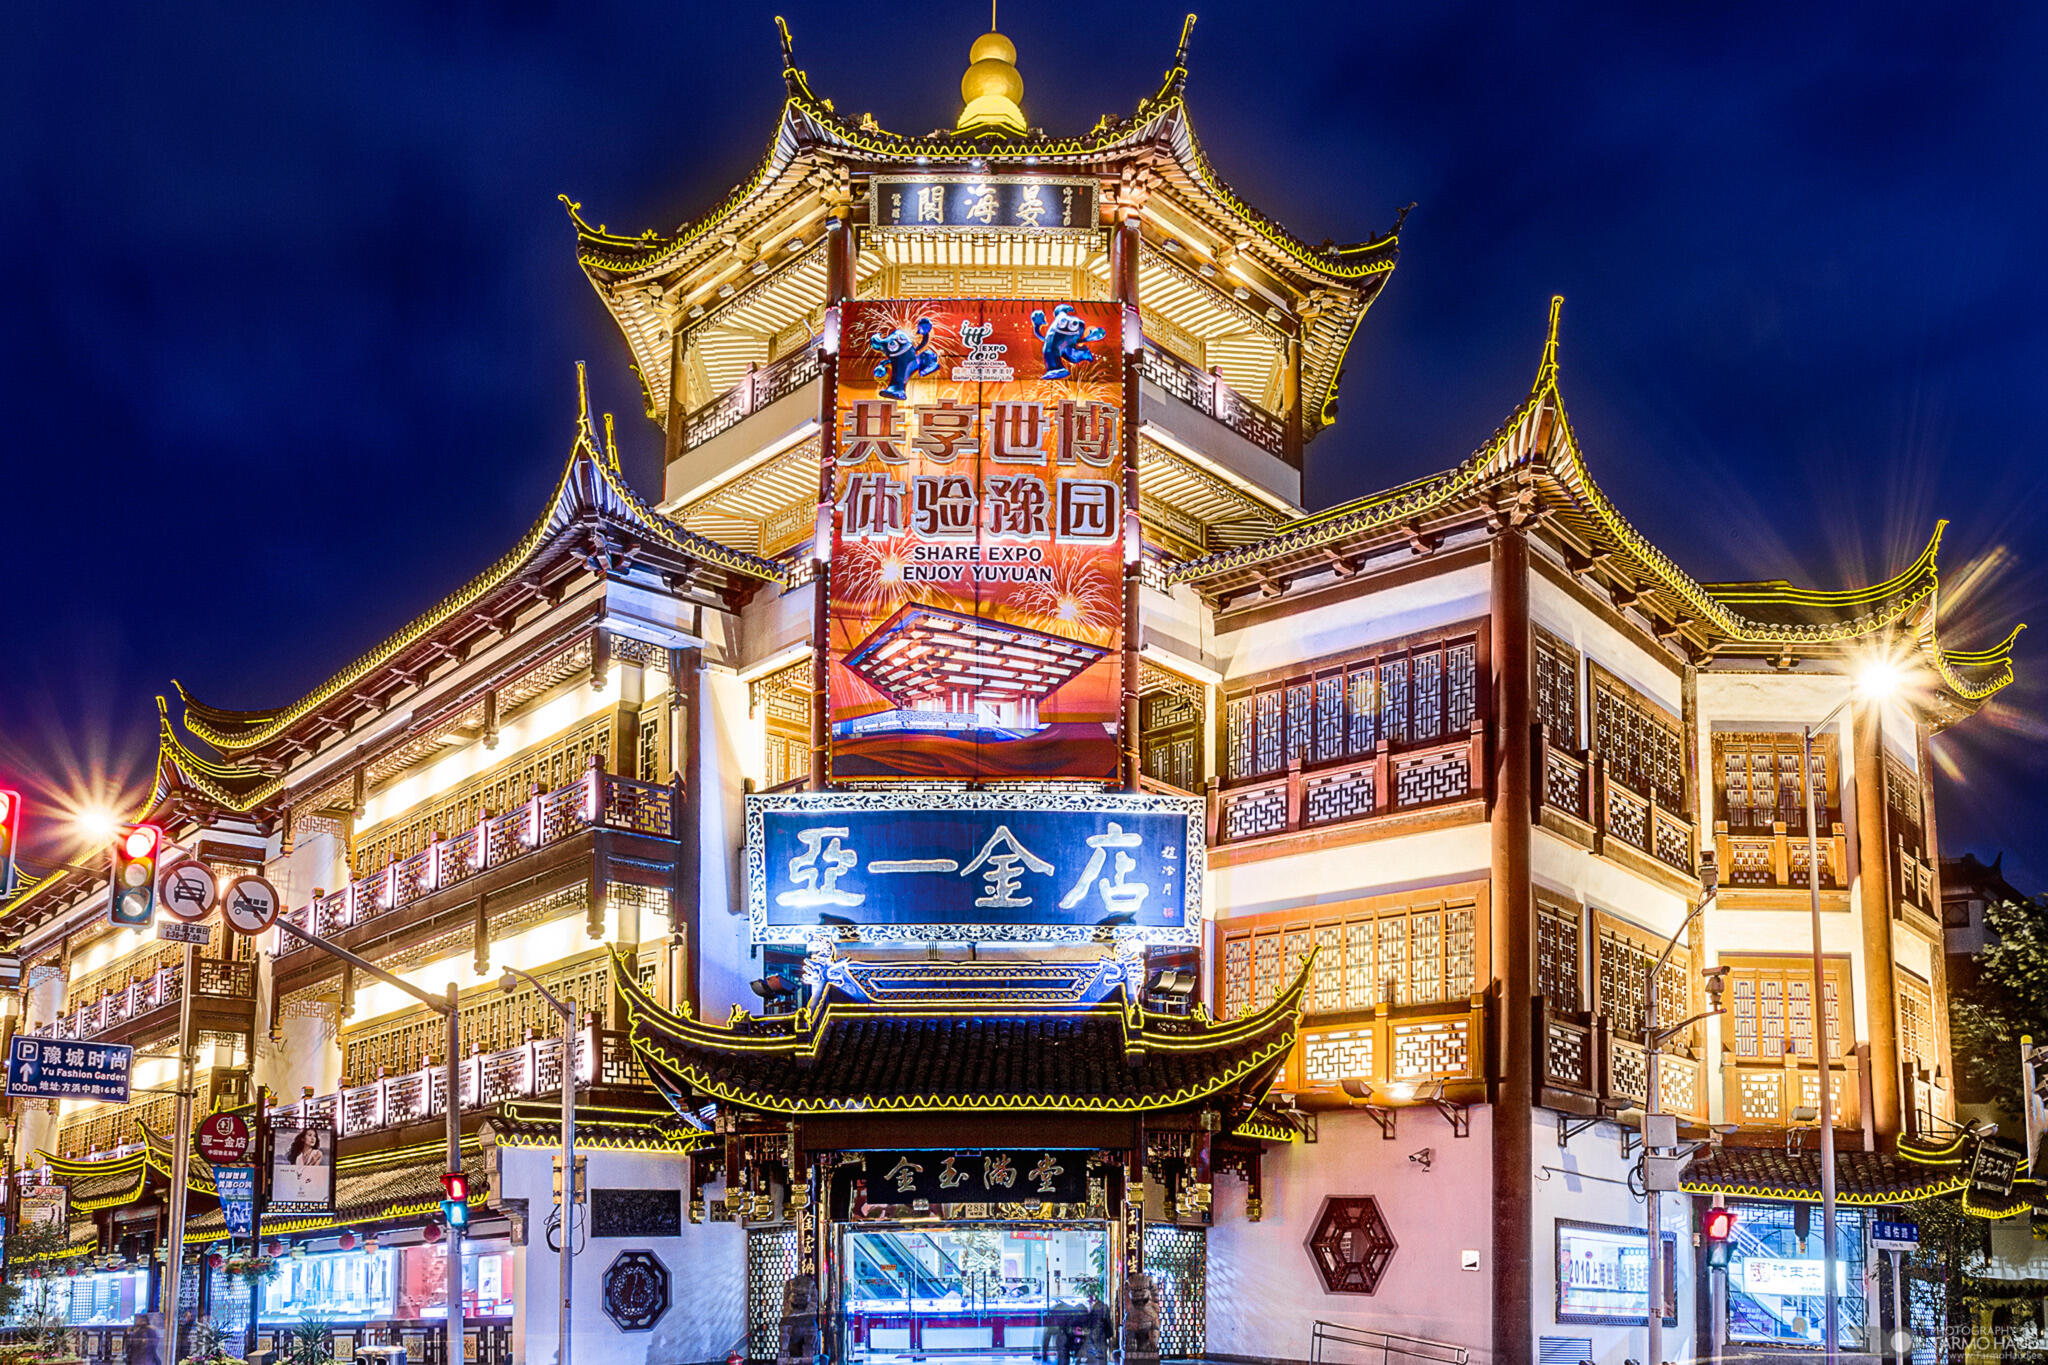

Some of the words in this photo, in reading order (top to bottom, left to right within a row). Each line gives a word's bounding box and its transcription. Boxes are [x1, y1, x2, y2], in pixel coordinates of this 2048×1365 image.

[969, 345, 997, 360] 2010
[837, 399, 1120, 469] 共享世博
[836, 472, 1120, 546] 体验豫园
[913, 546, 981, 562] SHARE
[987, 546, 1042, 562] EXPO
[902, 565, 965, 582] ENJOY
[968, 565, 1053, 582] YUYUAN
[21, 1044, 34, 1058] P
[42, 1046, 127, 1071] 豫城时尚
[41, 1067, 55, 1076] Yu
[56, 1068, 92, 1079] Fashion
[94, 1072, 127, 1082] Garden
[11, 1083, 37, 1092] 100m
[201, 1134, 246, 1149] 亚一金店
[967, 1203, 985, 1212] 288
